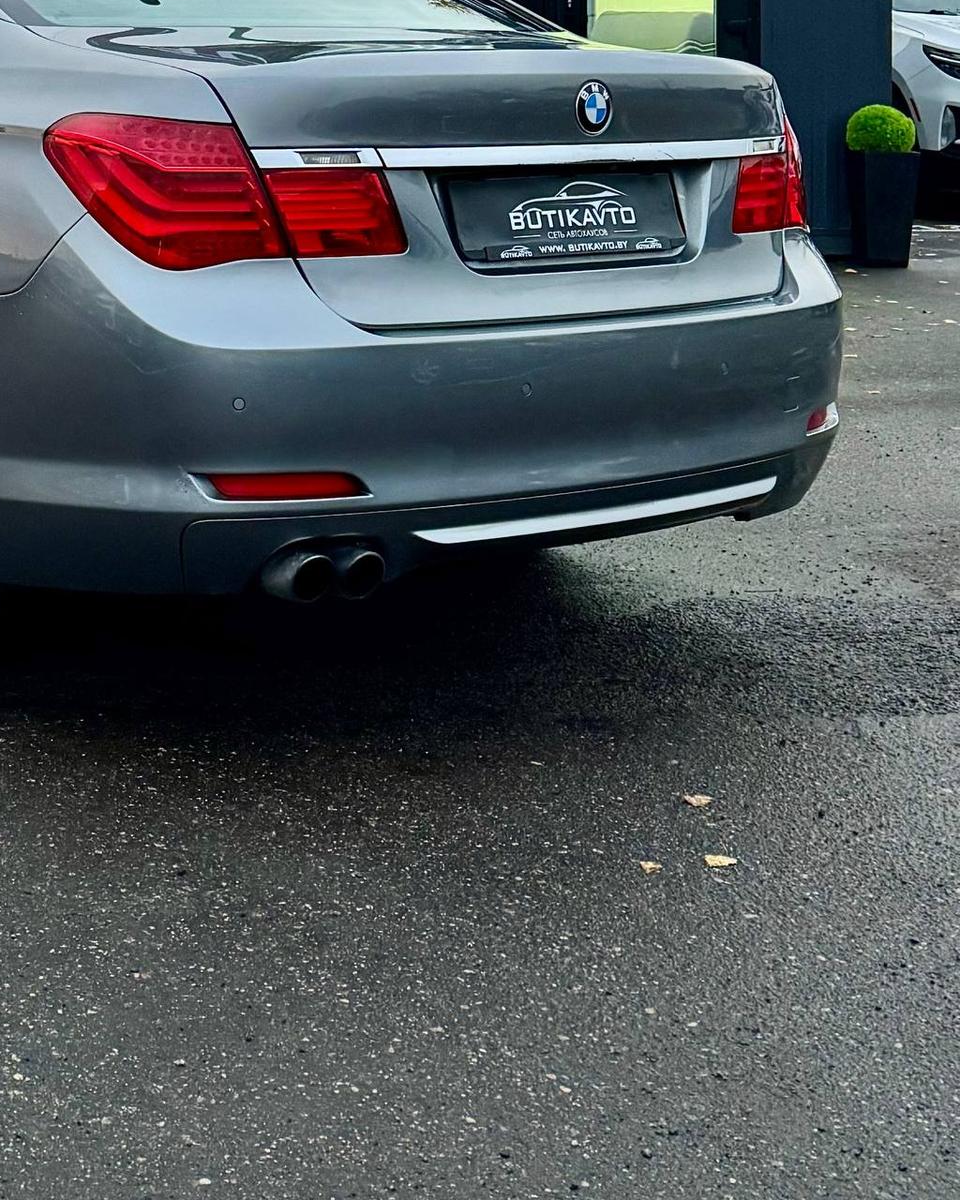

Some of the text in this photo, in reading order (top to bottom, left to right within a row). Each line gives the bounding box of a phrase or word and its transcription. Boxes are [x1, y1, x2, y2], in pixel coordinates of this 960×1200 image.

[580, 84, 610, 100] BMW
[508, 206, 637, 231] BUTIKAVTO
[547, 229, 609, 240] СЕТЬ АВТОХАУСОВ
